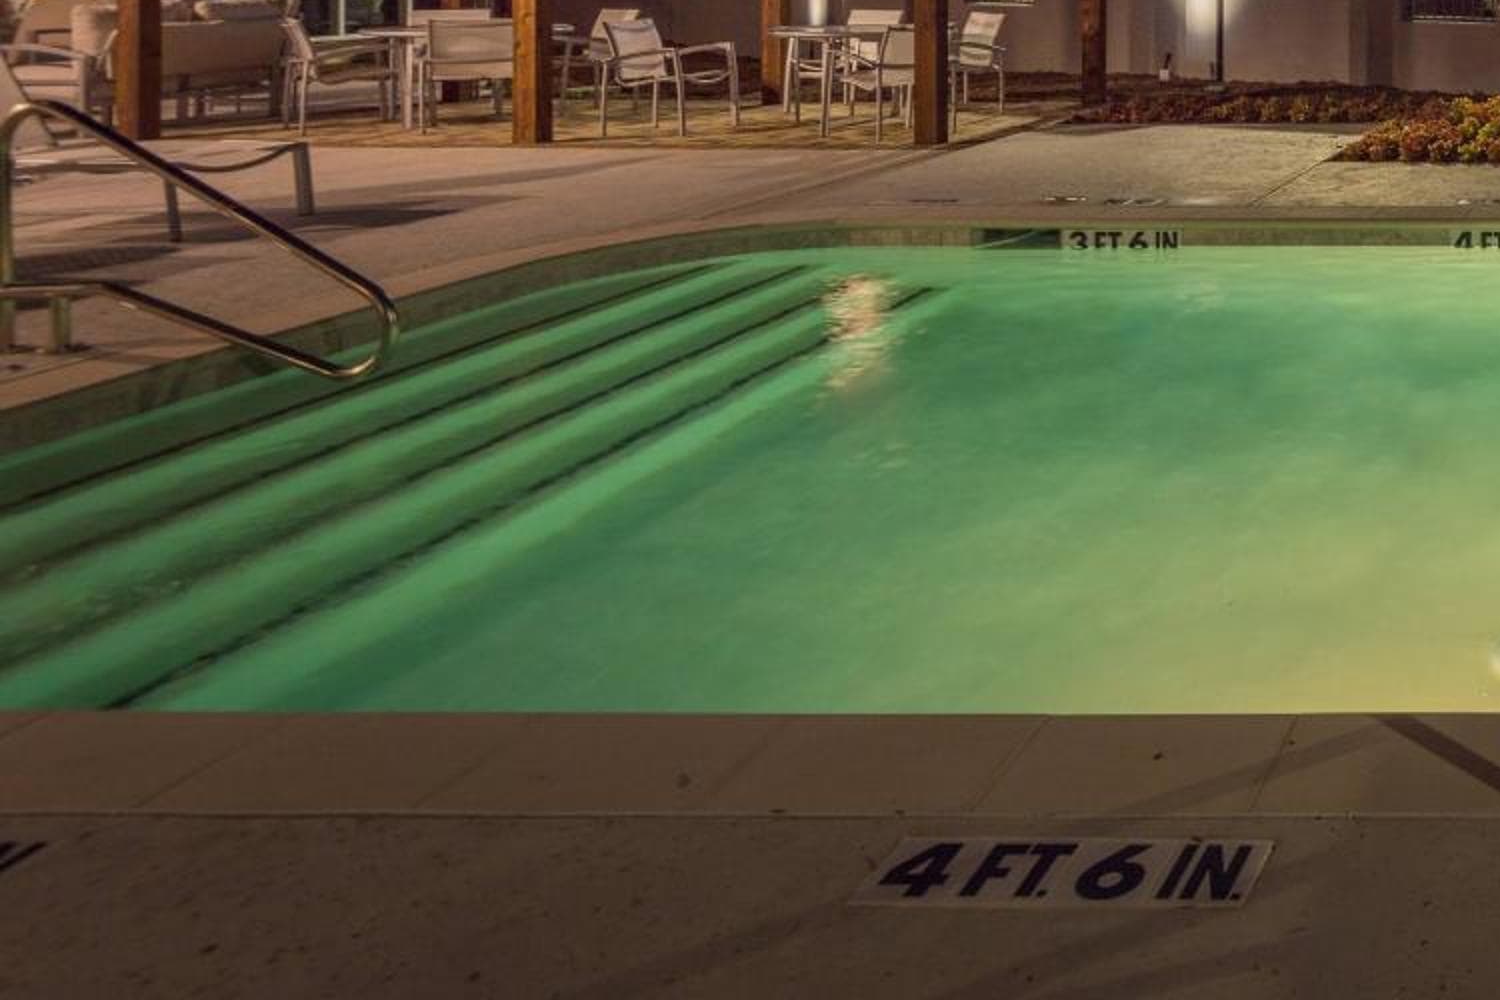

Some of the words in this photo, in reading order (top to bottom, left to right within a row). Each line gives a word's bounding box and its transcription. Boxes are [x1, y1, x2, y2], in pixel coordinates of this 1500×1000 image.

[1069, 231, 1088, 249] 3
[1095, 231, 1123, 248] FT
[1129, 231, 1148, 248] 6
[1155, 231, 1178, 248] IN
[877, 842, 963, 897] 4
[959, 843, 1079, 897] FT.
[1075, 844, 1153, 901] 6
[1154, 844, 1253, 901] IN.
